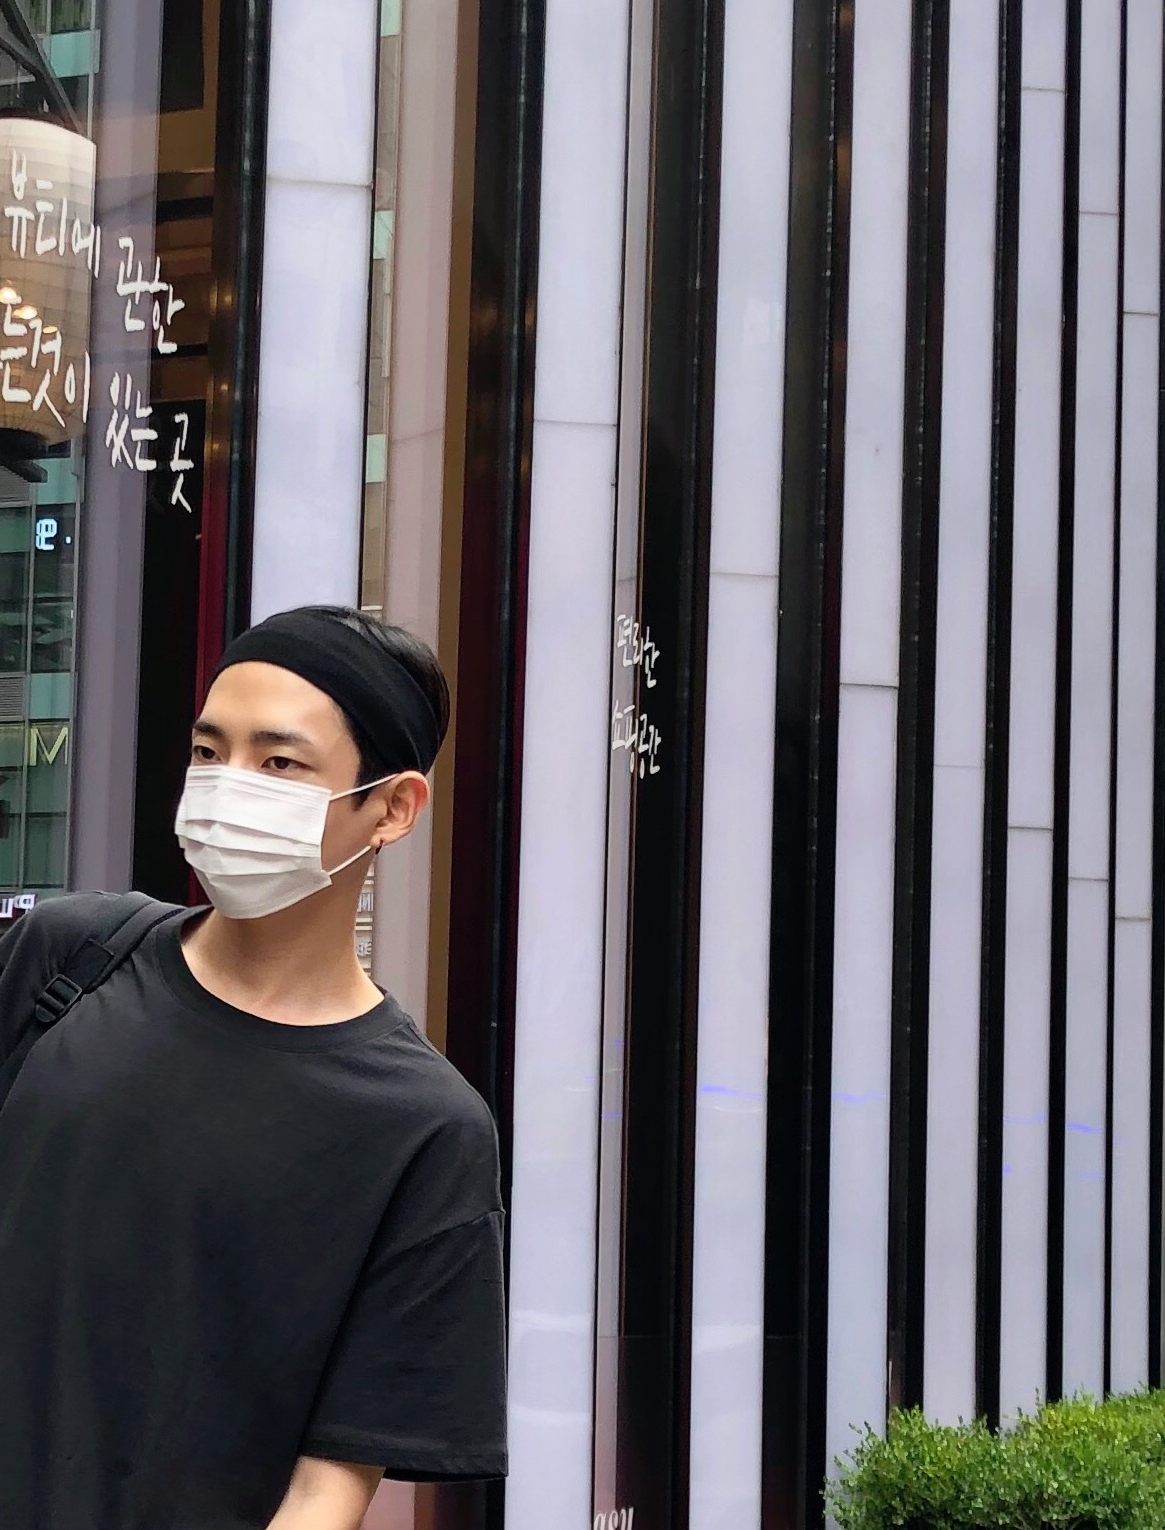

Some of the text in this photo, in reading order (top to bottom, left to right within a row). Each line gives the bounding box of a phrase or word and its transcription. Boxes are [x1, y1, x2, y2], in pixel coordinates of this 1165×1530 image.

[117, 236, 185, 354] 관한
[106, 371, 159, 471] 있는
[170, 412, 195, 513] 곳
[616, 613, 661, 689] 편리한
